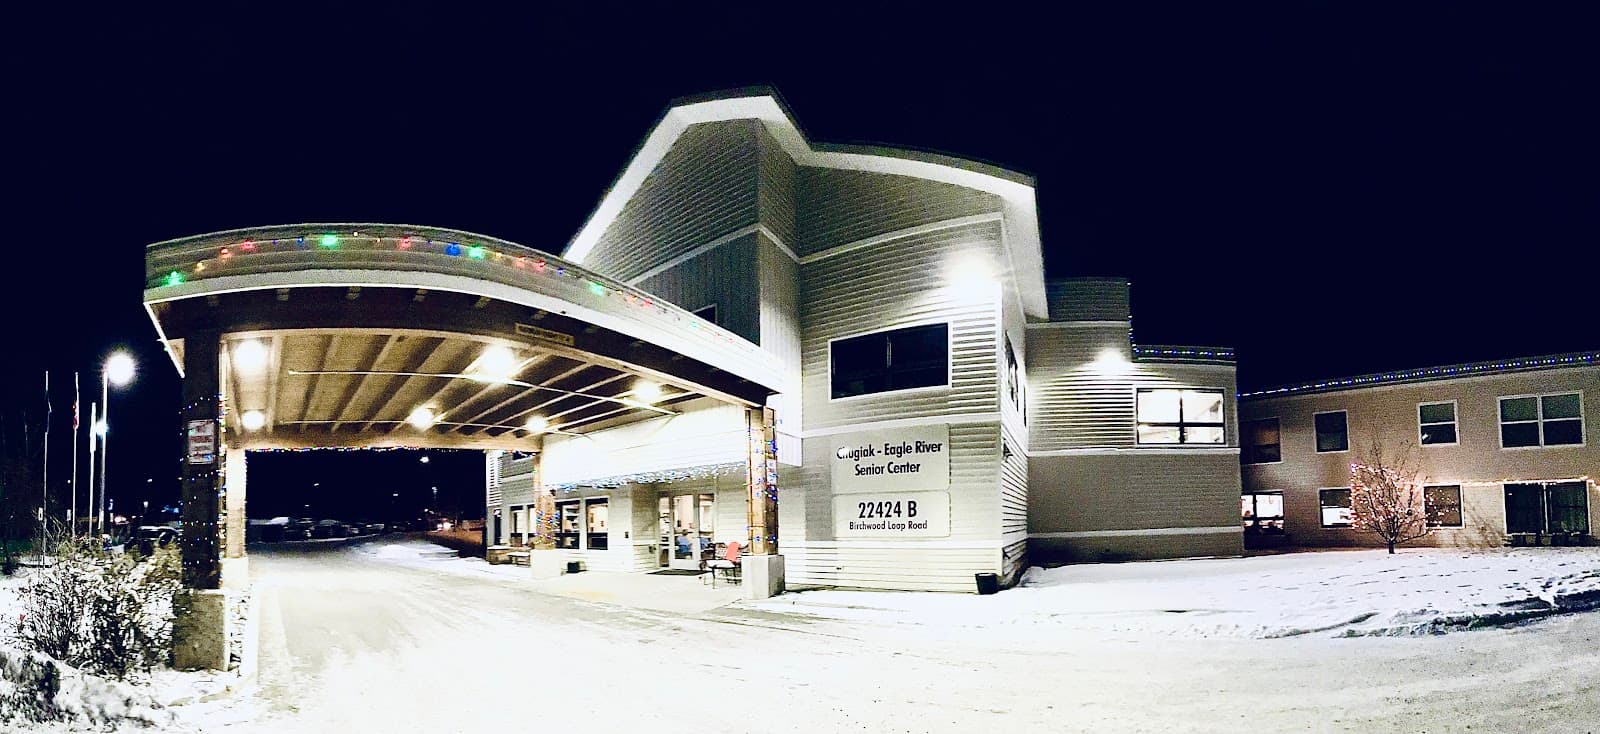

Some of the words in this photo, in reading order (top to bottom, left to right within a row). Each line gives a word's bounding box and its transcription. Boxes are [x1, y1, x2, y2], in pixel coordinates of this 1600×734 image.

[837, 444, 875, 461] Cugiak
[884, 441, 913, 458] Eagle
[915, 440, 942, 453] River
[855, 463, 885, 476] Senior
[887, 461, 921, 474] Center
[858, 501, 902, 518] 22424
[907, 500, 917, 518] B
[849, 521, 886, 530] Birchwood
[888, 521, 906, 531] Loop
[908, 520, 928, 530] Road
